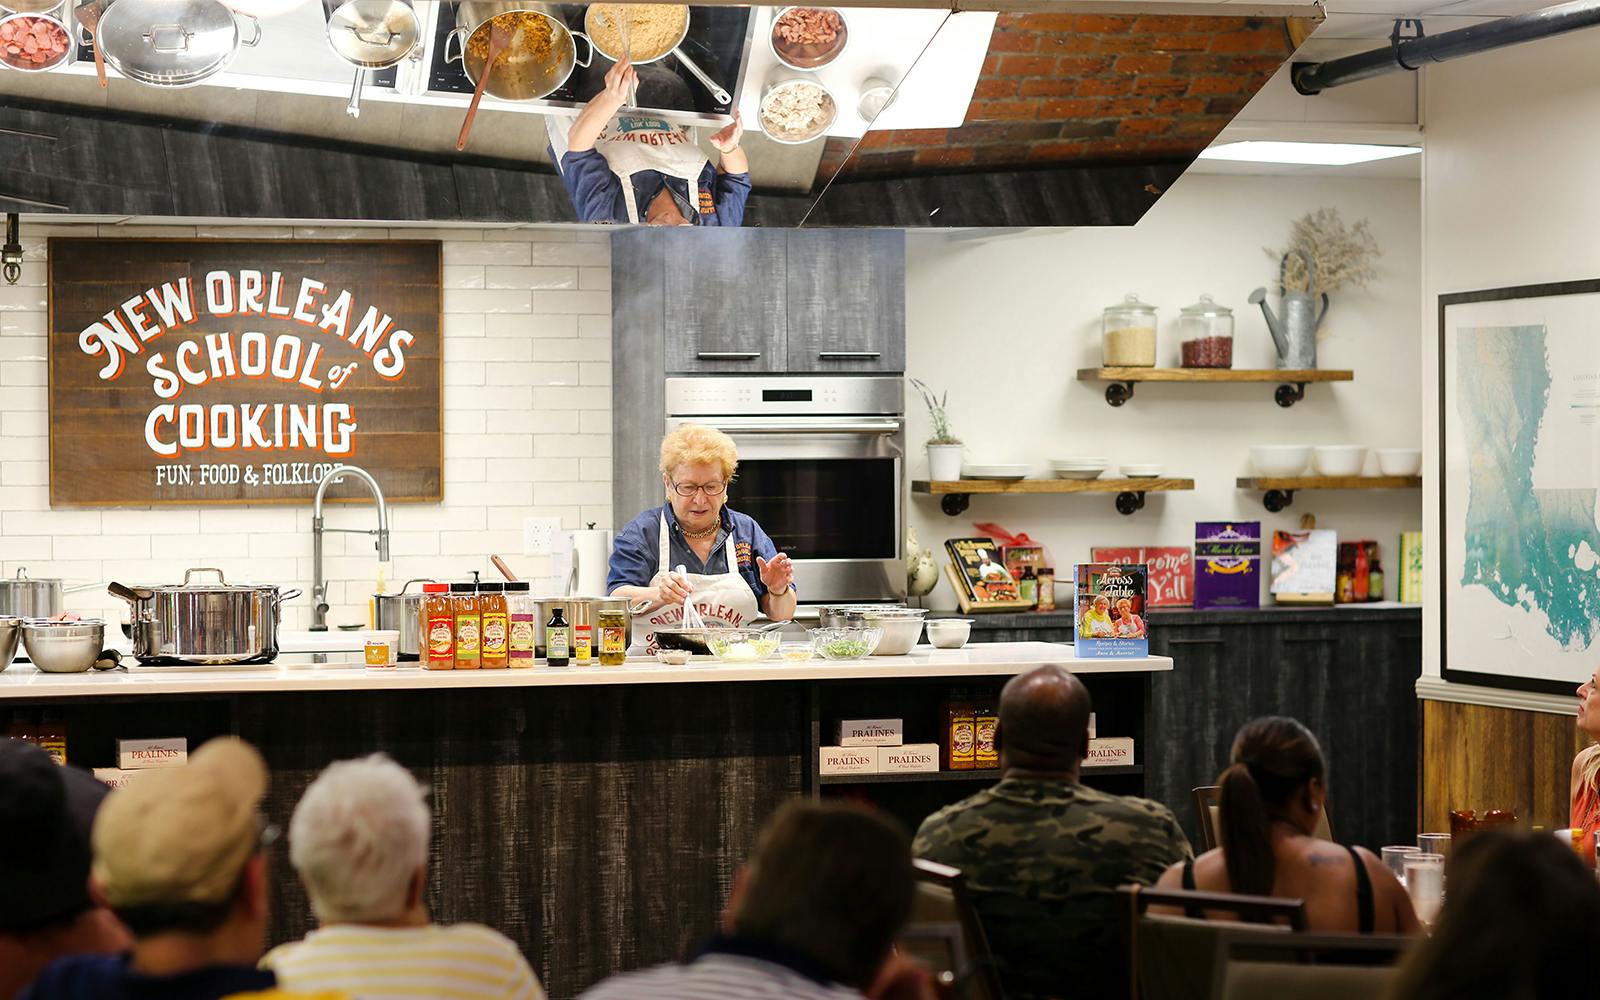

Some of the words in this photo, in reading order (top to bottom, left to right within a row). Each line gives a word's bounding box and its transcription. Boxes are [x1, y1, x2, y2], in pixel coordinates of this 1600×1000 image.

[78, 276, 197, 380] NEW
[205, 269, 415, 379] ORLEANS
[146, 331, 324, 399] SCHOOL
[327, 361, 358, 391] of
[144, 402, 357, 459] COOKING
[155, 464, 195, 487] FUN,
[199, 463, 240, 485] FOOD
[243, 464, 259, 487] &
[1096, 573, 1133, 585] Across
[1149, 571, 1187, 602] Y'all
[1104, 584, 1134, 598] Table
[650, 606, 684, 625] NEW
[852, 728, 895, 738] PRALINES
[131, 749, 178, 759] PRALINES
[827, 757, 871, 765] PRALINES
[888, 755, 932, 764] PRALINES
